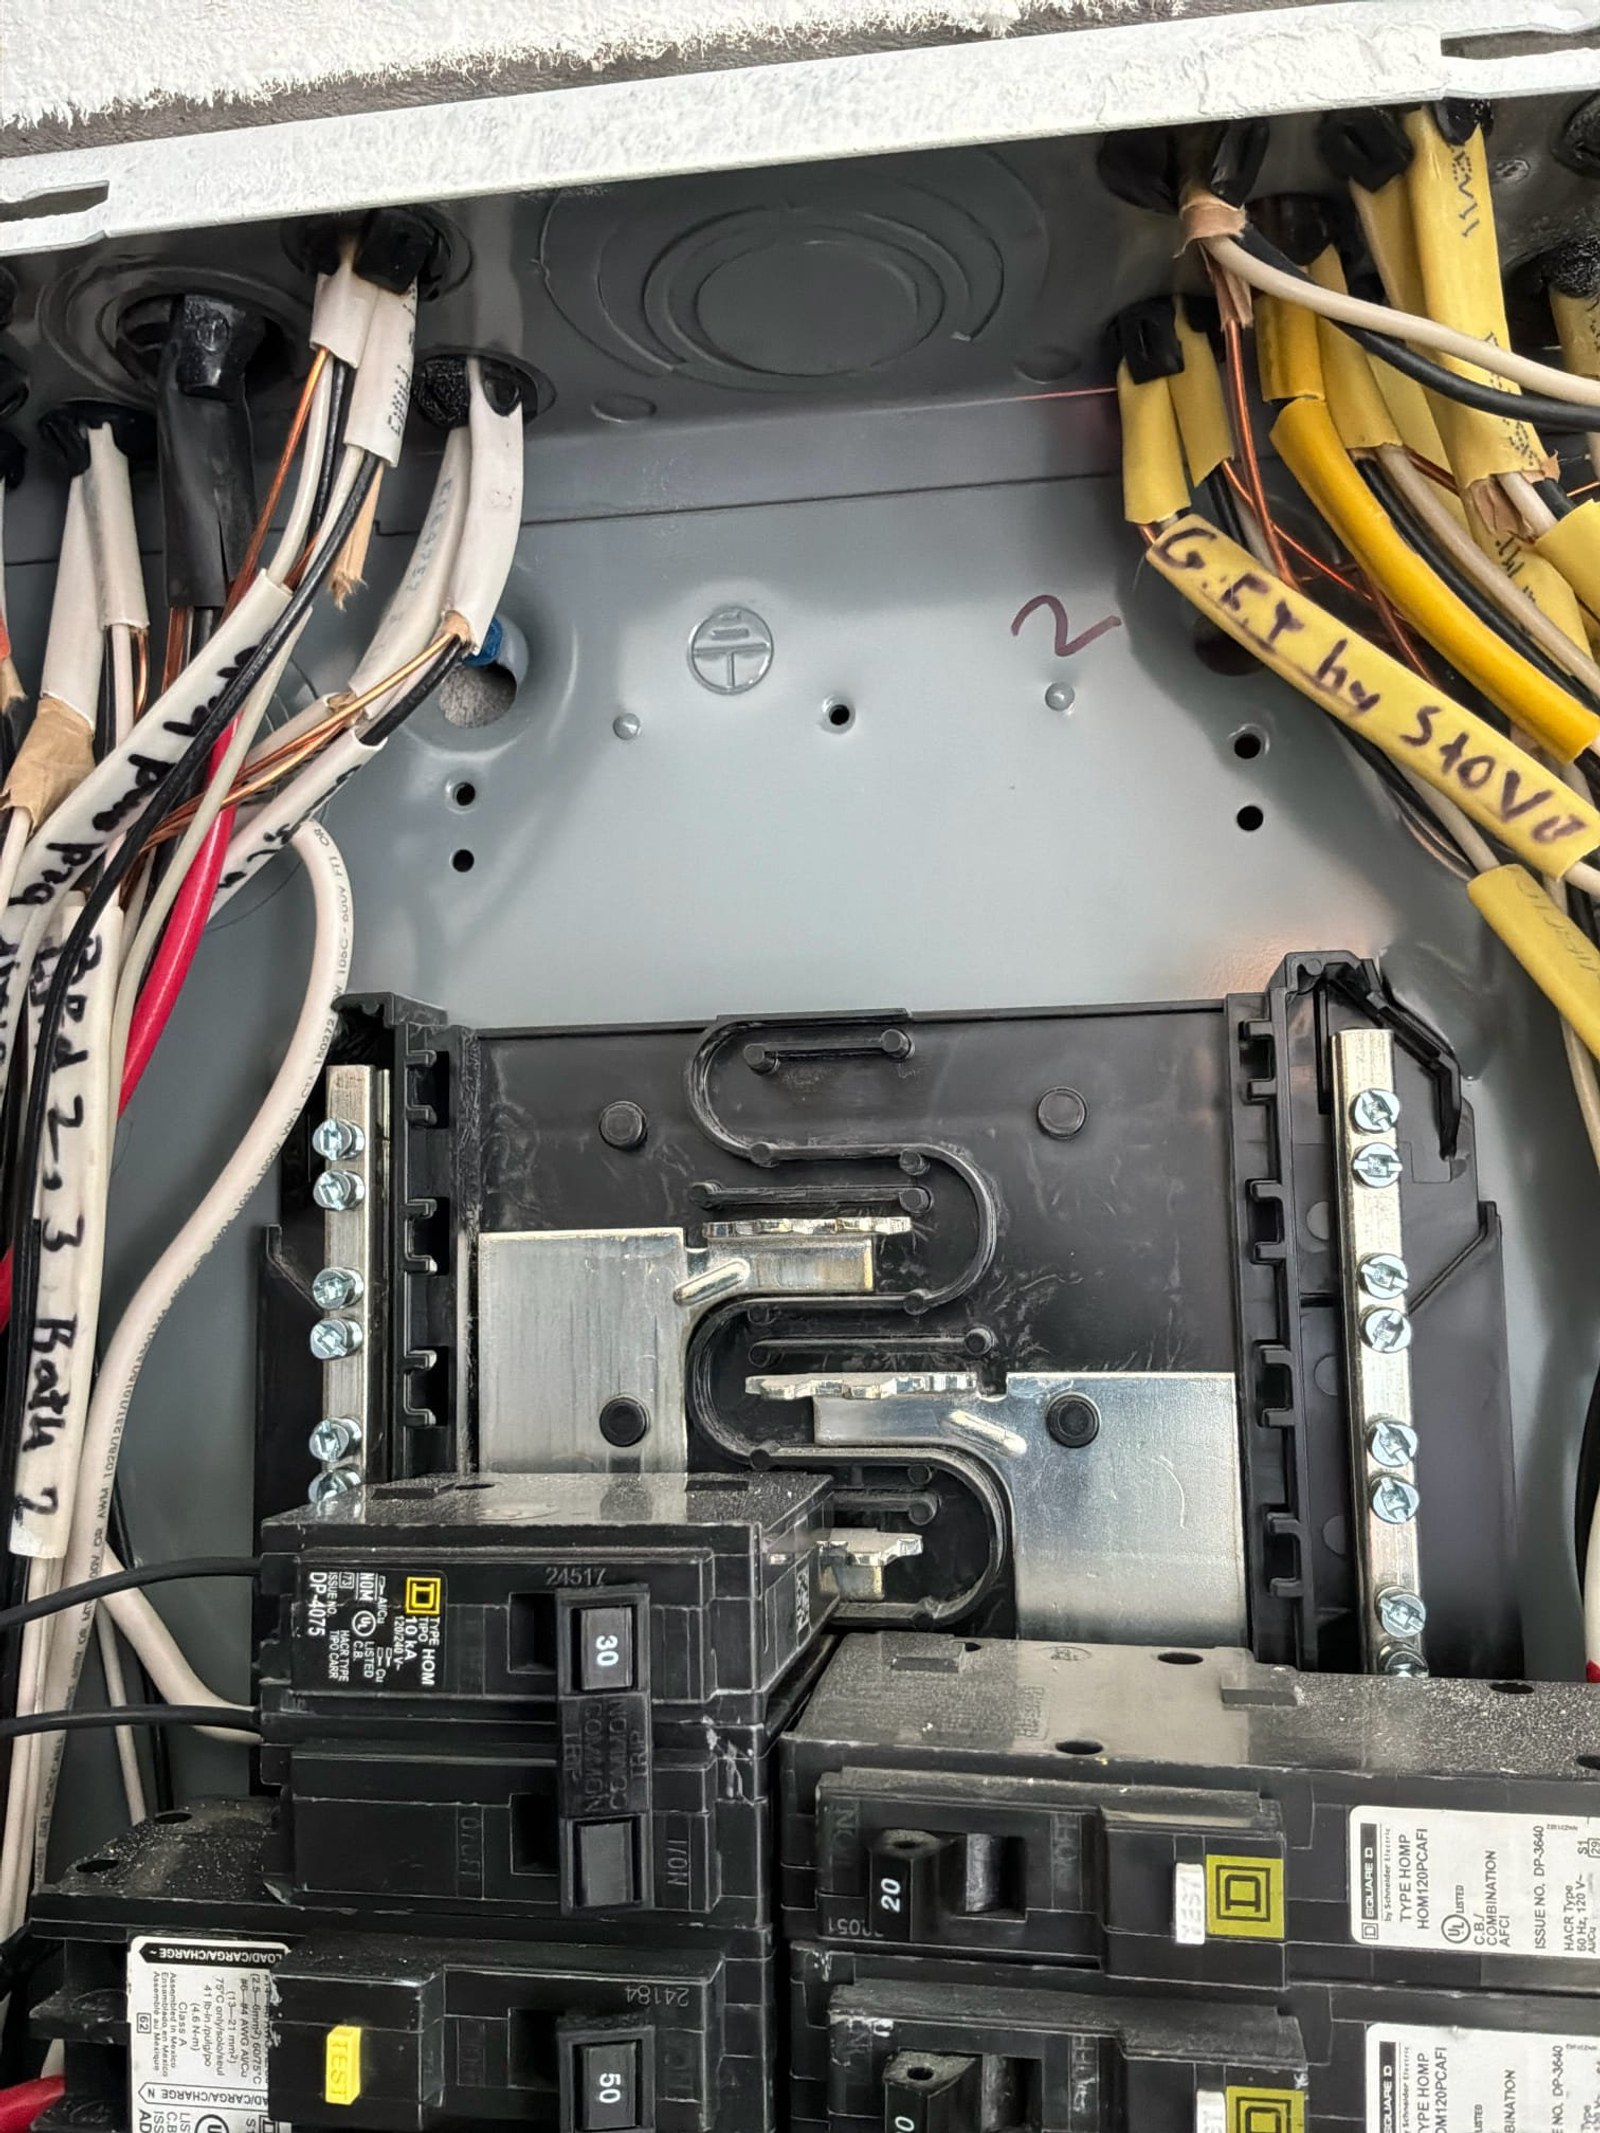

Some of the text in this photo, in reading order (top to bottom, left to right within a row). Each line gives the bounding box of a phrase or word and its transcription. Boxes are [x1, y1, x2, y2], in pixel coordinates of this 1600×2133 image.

[1010, 594, 1123, 657] 2
[43, 1214, 85, 1252] 3
[15, 1486, 59, 1527] 2
[326, 1572, 338, 1618] ISSUE NO.
[342, 1575, 352, 1586] 73
[360, 1572, 375, 1600] NOM
[308, 1571, 326, 1636] DP-4075
[353, 1640, 363, 1661] C.B.
[393, 1615, 404, 1654] 120/240
[404, 1616, 418, 1660] 10 kA
[418, 1617, 429, 1642] TIPO
[595, 1635, 619, 1666] 30
[328, 1630, 339, 1679] TIPO CARR
[339, 1630, 350, 1682] HACR TYPE
[363, 1641, 374, 1678] LISTED
[421, 1617, 440, 1685] TYPE HOM
[375, 1668, 386, 1683] Cu
[880, 1877, 901, 1913] 20
[1364, 1846, 1375, 1918] SQUARE D
[1383, 1864, 1391, 1909] Schneider
[1399, 1833, 1412, 1922] TYPE HOMP
[1416, 1828, 1430, 1929] HOM120PCAFI
[1485, 1850, 1497, 1946] COMBINATION
[1533, 1825, 1546, 1949] ISSUE NO. DP-3640
[1456, 1884, 1465, 1914] LISTED
[1563, 1884, 1575, 1951] HACR Type
[1576, 1893, 1586, 1912] 120
[1499, 1915, 1511, 1947] AFCI
[169, 1972, 177, 2022] Assembled
[623, 1985, 689, 2007] 24184
[139, 2015, 148, 2030] 62
[178, 2001, 187, 2047] Class A
[240, 2018, 249, 2046] AWG
[330, 2041, 348, 2100] TEST
[599, 2072, 621, 2103] 50
[1383, 2065, 1392, 2077] D
[1417, 2053, 1430, 2098] HOMP
[1551, 2045, 1564, 2097] DP-3640
